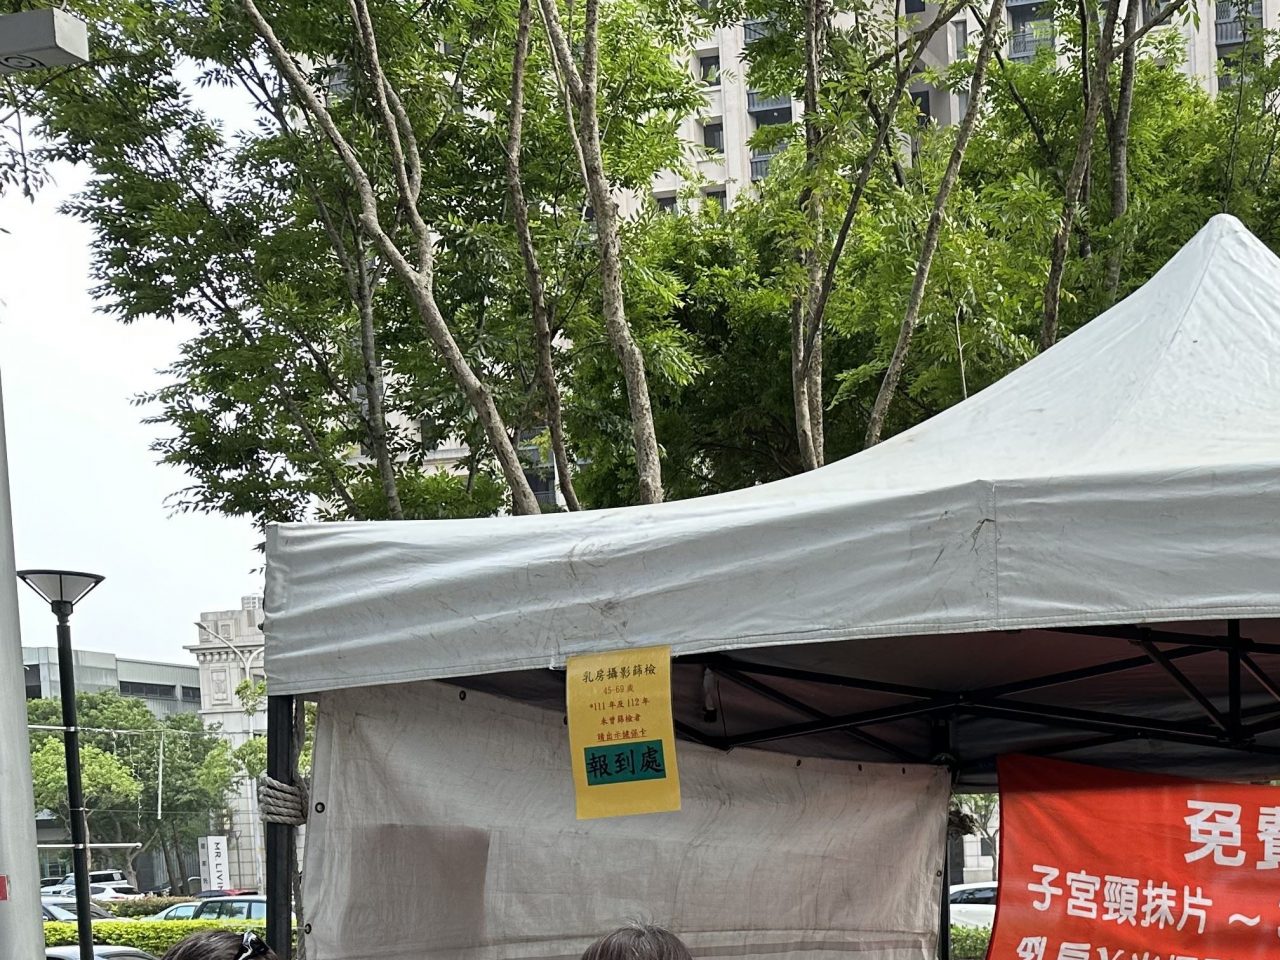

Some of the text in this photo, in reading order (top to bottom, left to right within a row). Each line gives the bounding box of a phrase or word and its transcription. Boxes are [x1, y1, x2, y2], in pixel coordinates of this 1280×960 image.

[582, 664, 657, 683] 乳房攝影篩檢
[586, 746, 665, 778] 報到處
[1027, 864, 1214, 935] 子宮頸抹片
